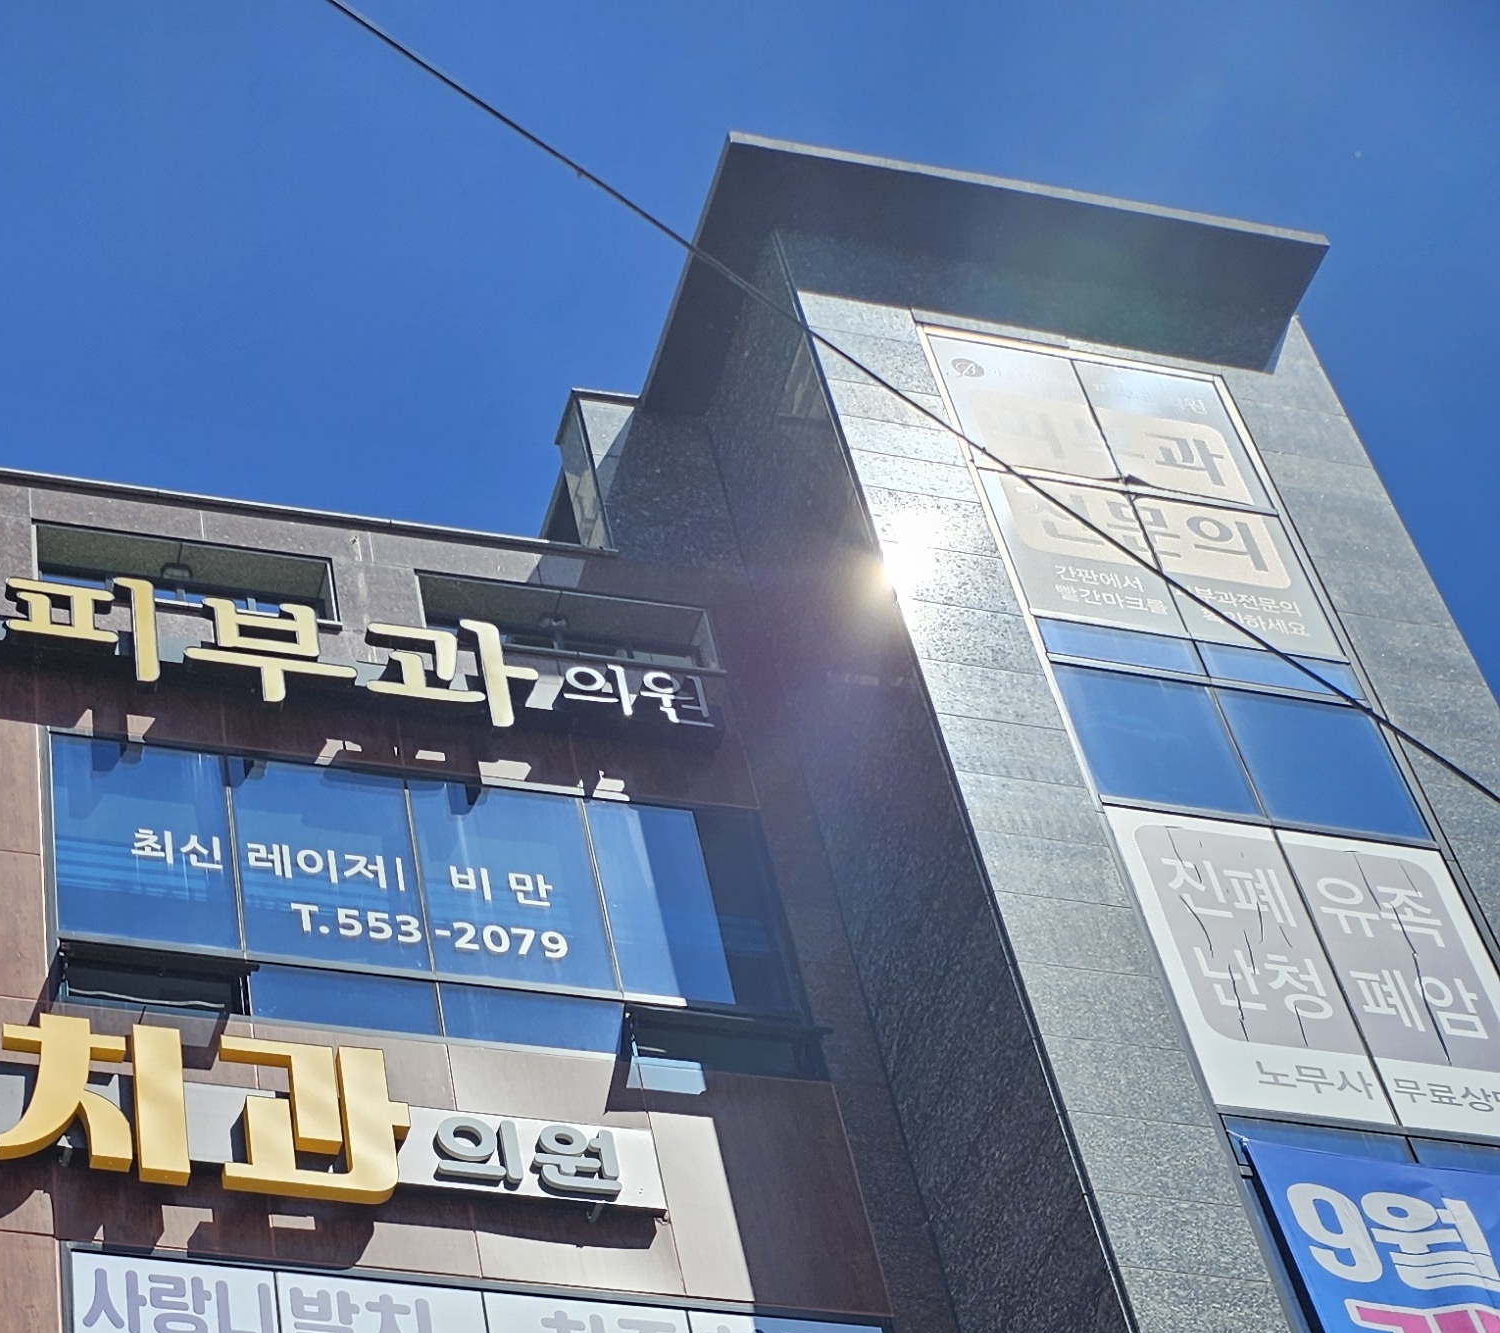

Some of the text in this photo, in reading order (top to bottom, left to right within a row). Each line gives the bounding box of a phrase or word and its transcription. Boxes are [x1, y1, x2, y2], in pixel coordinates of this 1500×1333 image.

[1054, 564, 1145, 592] 간판에서
[130, 827, 224, 873] 최신
[246, 841, 388, 891] 레이저
[290, 901, 569, 961] T.553-2079
[1160, 857, 1447, 948] 진폐 유족
[1193, 947, 1489, 1040] 난청 폐암
[1255, 1059, 1373, 1100] 노무사
